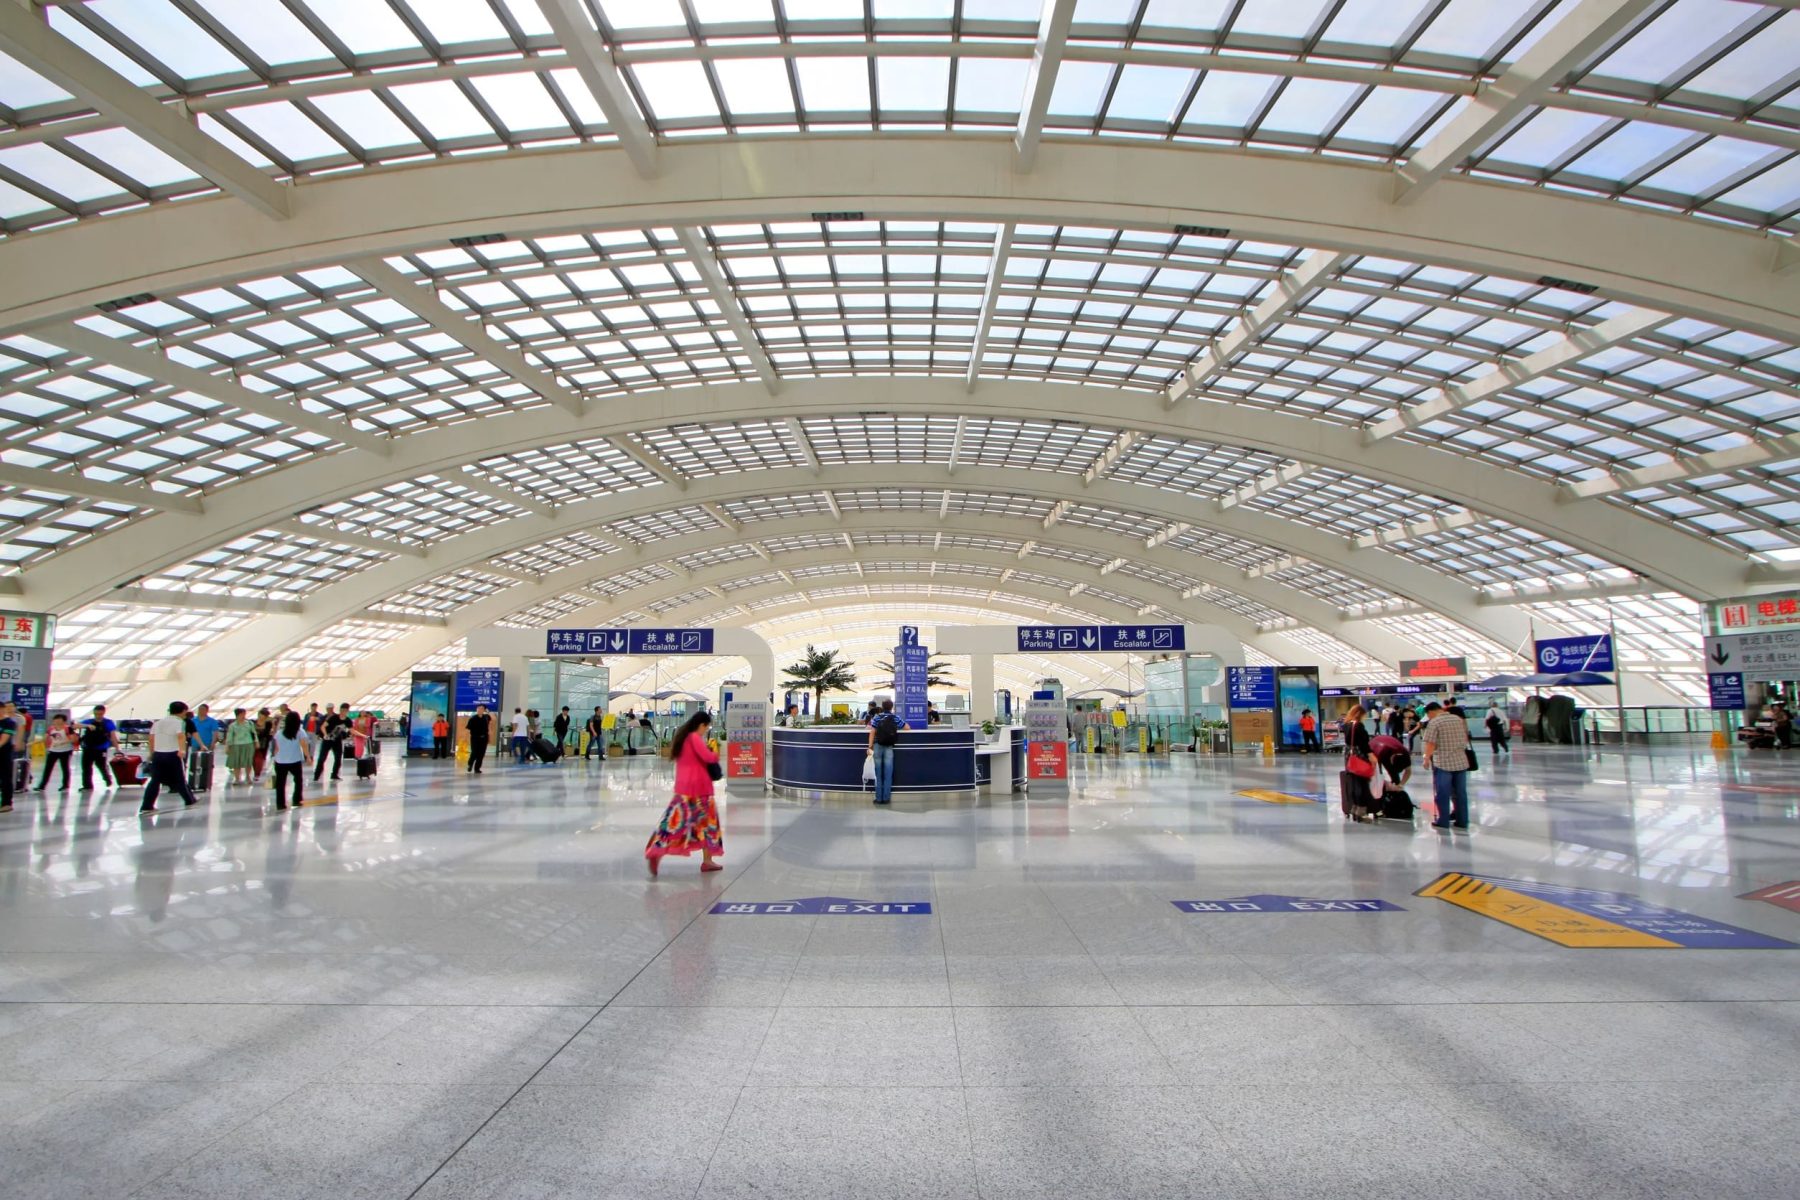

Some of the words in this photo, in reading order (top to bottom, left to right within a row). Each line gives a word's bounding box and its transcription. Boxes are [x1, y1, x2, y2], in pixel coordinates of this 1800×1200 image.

[550, 632, 585, 643] 停车场
[646, 632, 676, 643] 扶梯
[1021, 629, 1056, 640] 停车场
[1118, 630, 1146, 640] 扶梯
[553, 643, 582, 652] Parking
[642, 643, 679, 651] Escalator
[1023, 640, 1053, 649] Parking
[1113, 640, 1151, 648] Escalator
[3, 650, 21, 662] B1
[0, 668, 20, 680] B2
[726, 904, 795, 913] 出口
[827, 904, 917, 913] EXIT
[1191, 902, 1262, 912] 出口
[1288, 901, 1383, 910] EXIT
